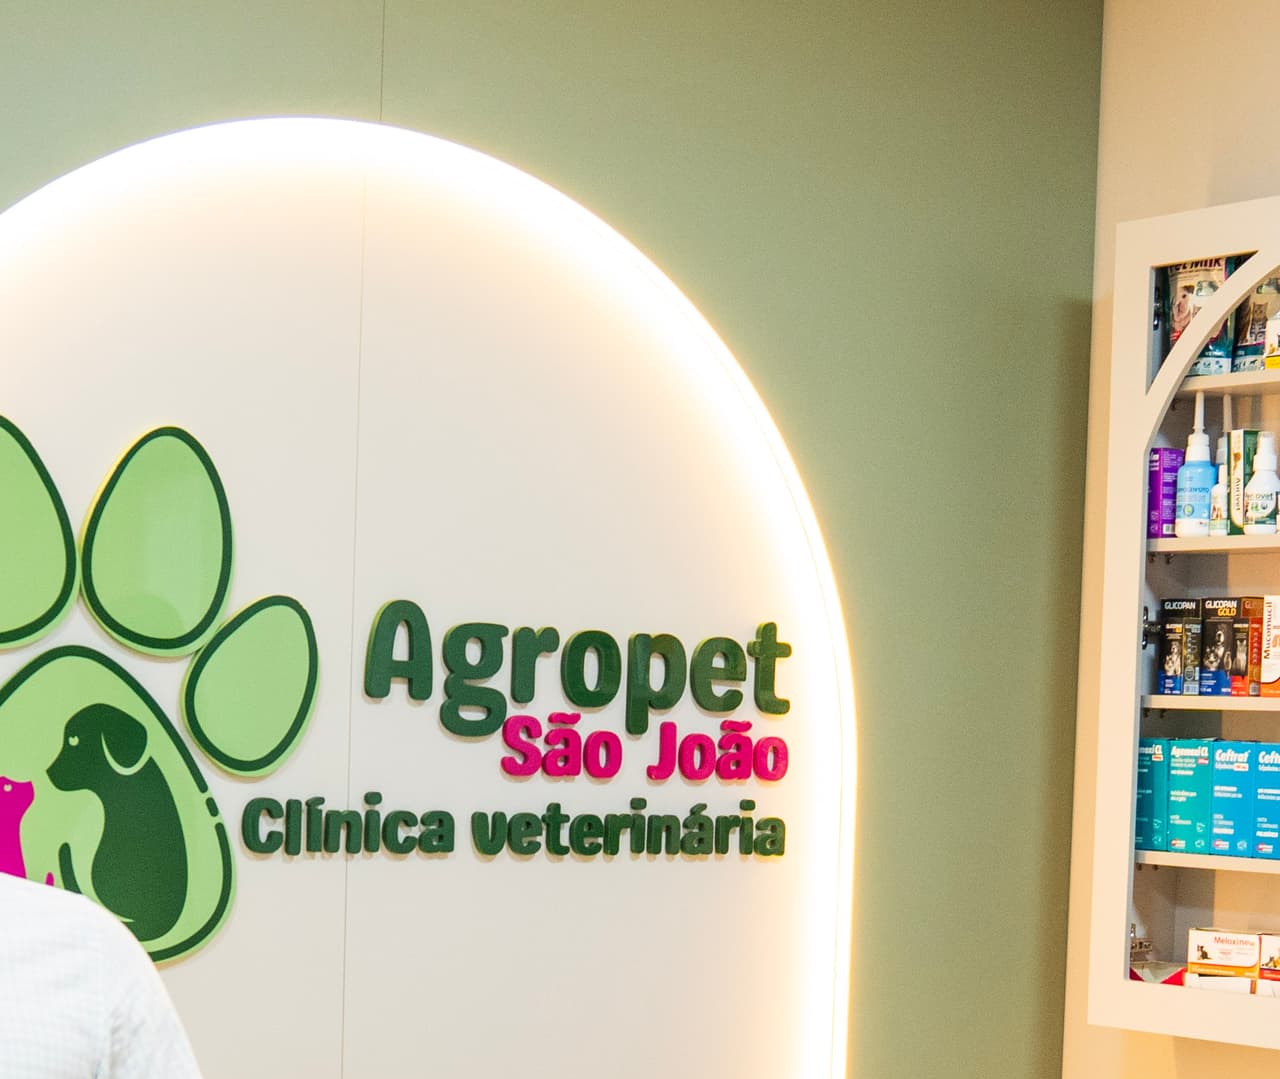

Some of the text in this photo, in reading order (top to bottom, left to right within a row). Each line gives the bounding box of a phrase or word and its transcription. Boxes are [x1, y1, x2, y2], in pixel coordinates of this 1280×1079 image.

[1164, 601, 1196, 610] GLICOPAN
[1205, 600, 1238, 609] GLICOPAN
[1218, 608, 1237, 616] GOLD
[1263, 601, 1273, 660] Mucomucil
[364, 599, 792, 737] Agropet
[500, 711, 789, 782] São João
[241, 791, 786, 857] Clínica veterinária
